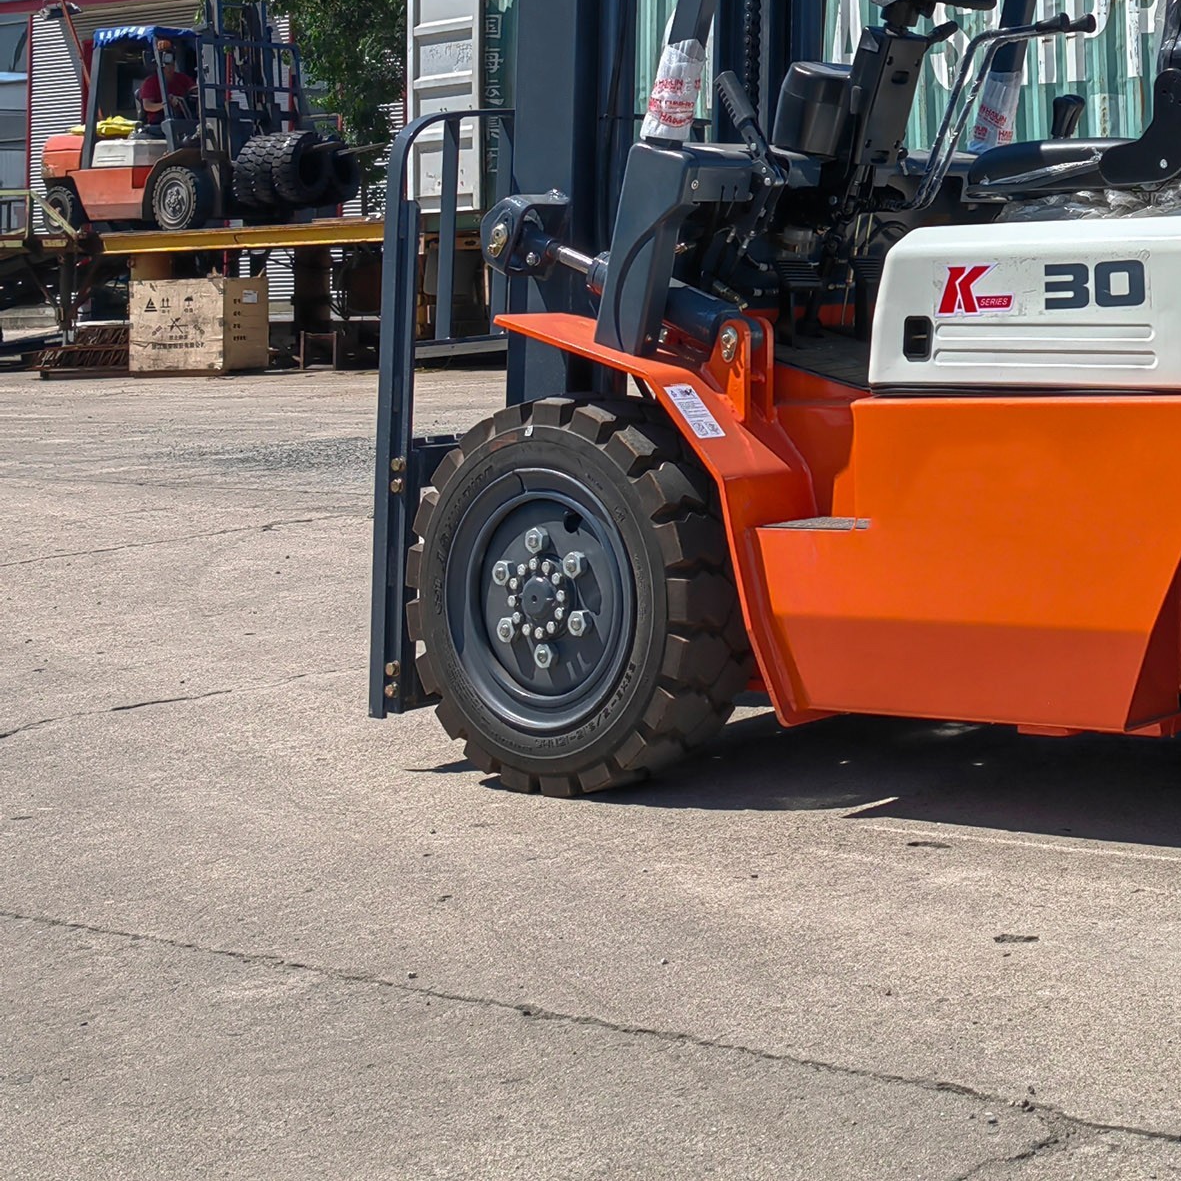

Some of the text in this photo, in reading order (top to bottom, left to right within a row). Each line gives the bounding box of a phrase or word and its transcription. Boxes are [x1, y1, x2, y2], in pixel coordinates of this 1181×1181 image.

[938, 265, 1009, 314] K SERIES
[1044, 259, 1146, 310] 30
